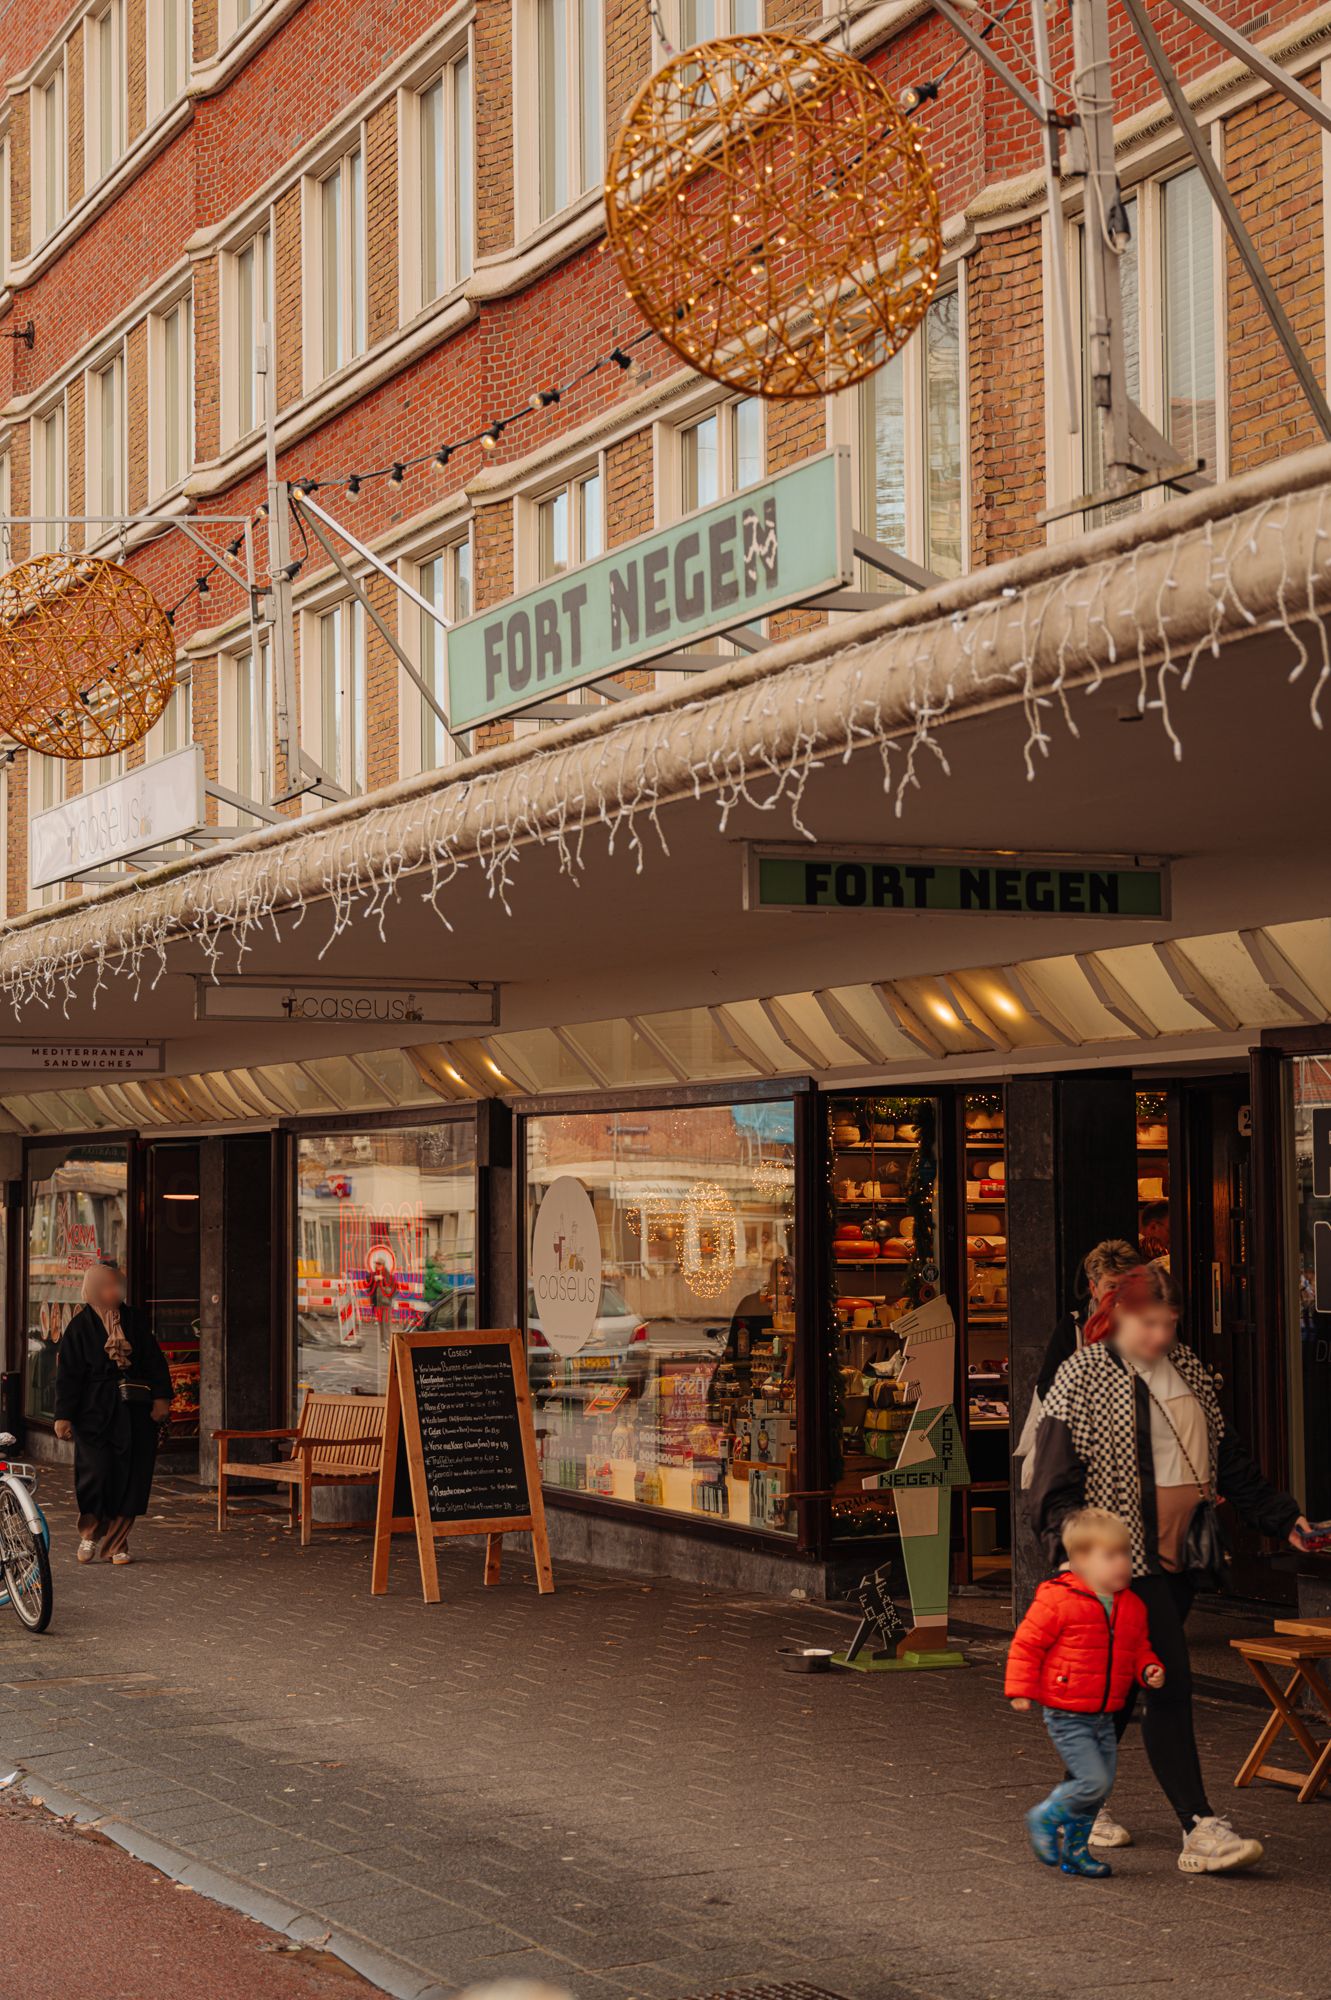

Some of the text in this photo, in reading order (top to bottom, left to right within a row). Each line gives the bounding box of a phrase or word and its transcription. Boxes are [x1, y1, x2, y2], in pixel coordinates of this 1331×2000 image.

[484, 497, 779, 703] FORT NEGEN
[79, 797, 140, 859] caseus
[804, 863, 1120, 914] FORT NEGEN
[302, 994, 404, 1020] caseus
[31, 1048, 144, 1057] MEDITERRANEAN
[43, 1059, 132, 1068] SANDWICHES
[538, 1274, 596, 1303] caseus
[942, 1413, 953, 1471] FORT
[879, 1472, 944, 1487] NEGEN
